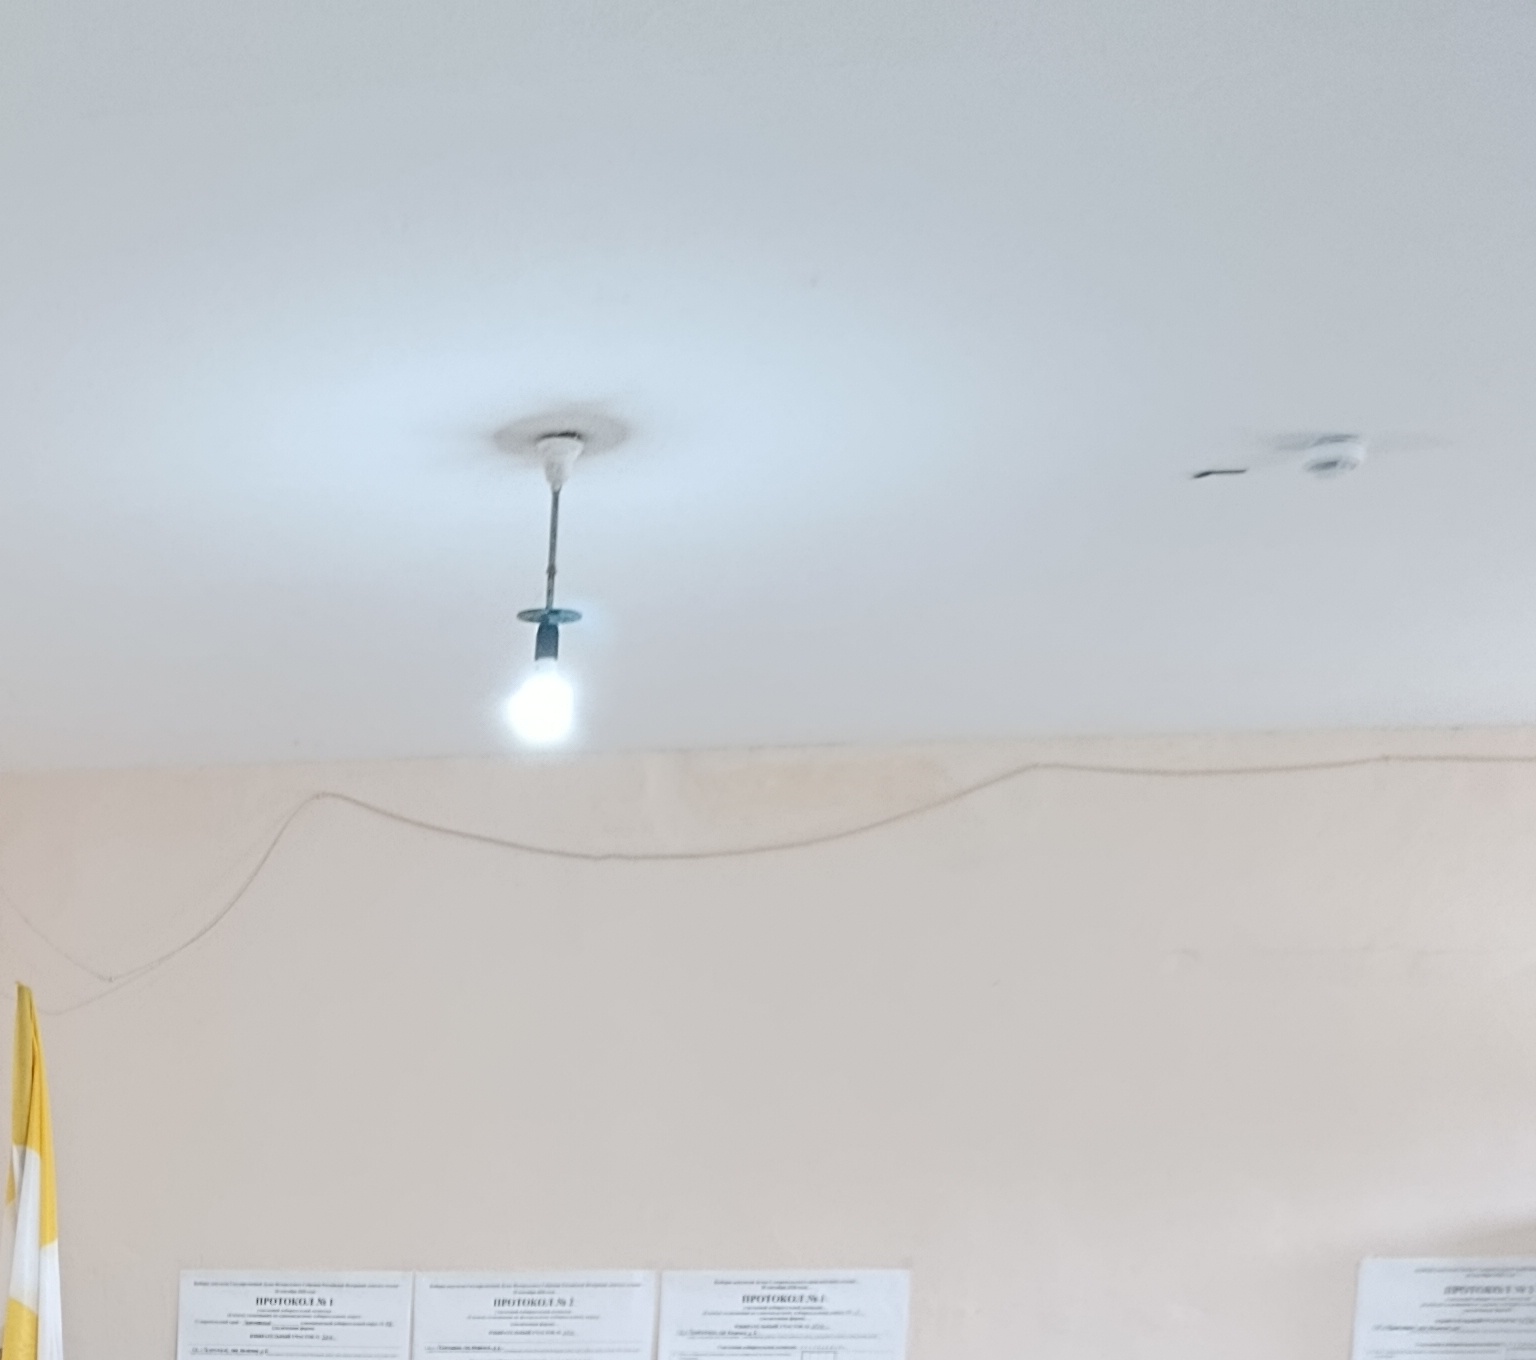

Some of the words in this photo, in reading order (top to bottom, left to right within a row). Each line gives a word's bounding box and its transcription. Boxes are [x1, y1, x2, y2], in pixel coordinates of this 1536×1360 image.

[255, 1297, 313, 1307] ПРОТОКОЛ
[493, 1298, 553, 1308] ПРОТОКОЛ
[742, 1295, 804, 1304] ПРОТОКОЛ
